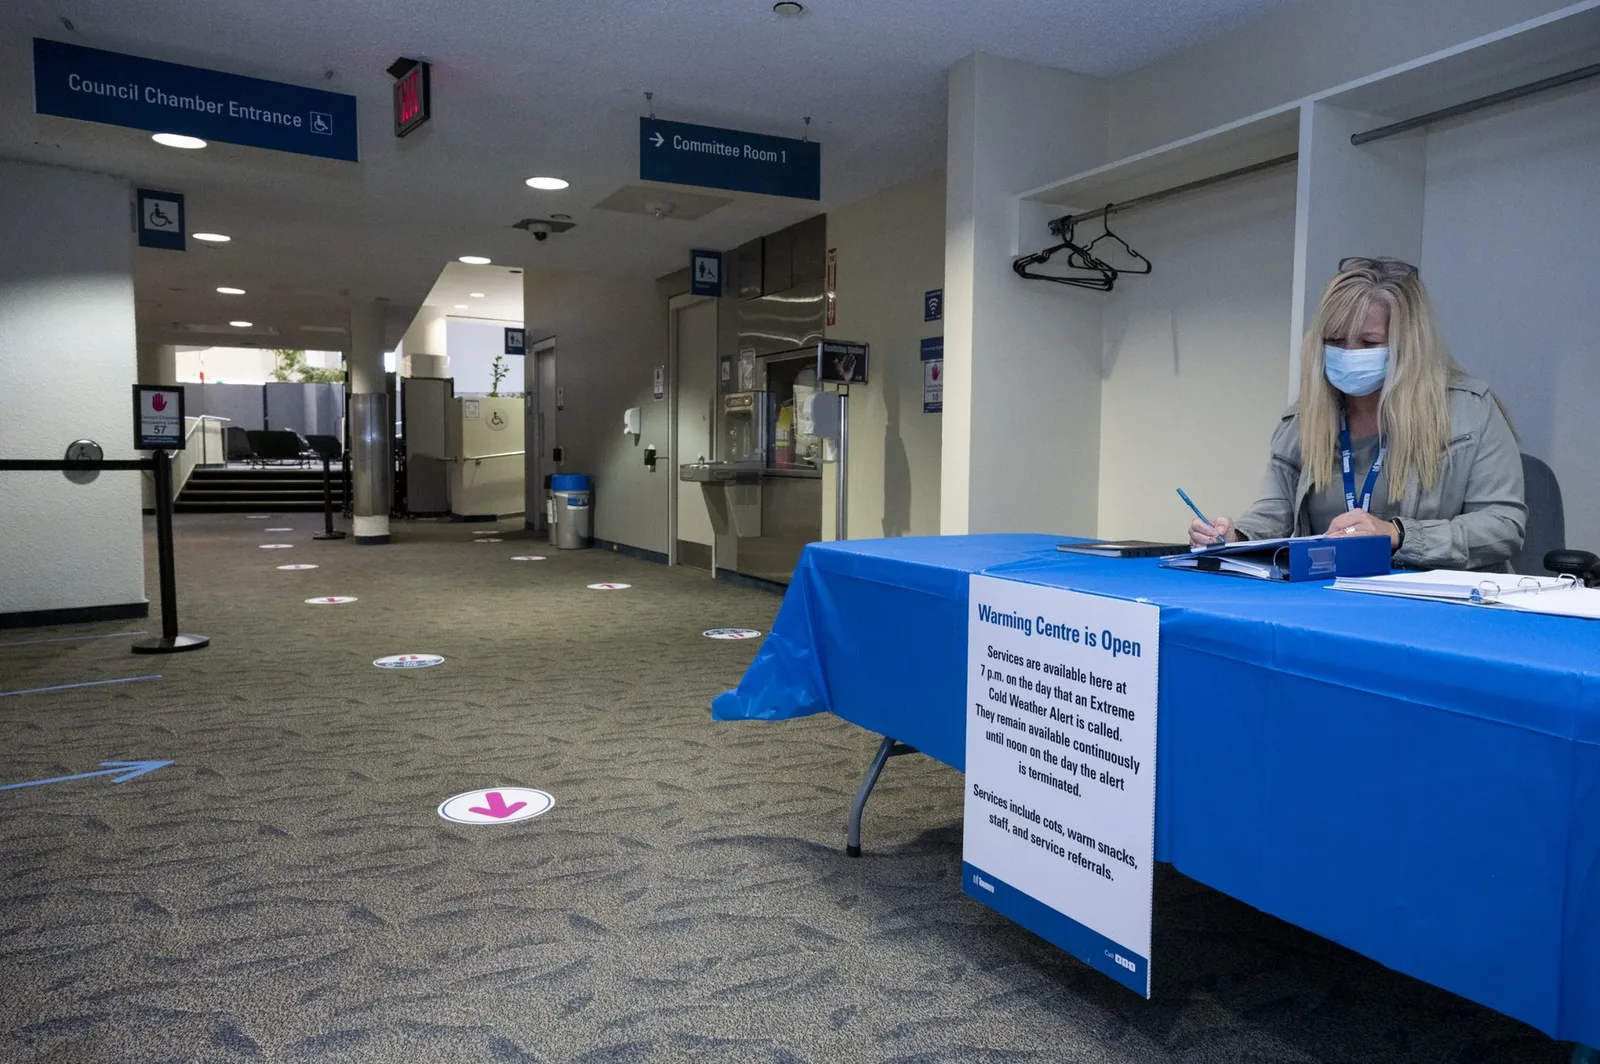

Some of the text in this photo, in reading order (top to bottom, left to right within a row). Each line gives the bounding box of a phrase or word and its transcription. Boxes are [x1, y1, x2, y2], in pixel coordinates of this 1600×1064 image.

[69, 73, 302, 128] Council Chamber Entrance
[673, 135, 786, 163] Committee Room 1
[153, 425, 167, 434] 57
[978, 603, 1141, 657] Warming Centre is Open
[980, 664, 1135, 721] 7 p.m. on the day that an Extreme
[987, 645, 1127, 694] Services are available here at
[975, 703, 1140, 775] They remain available continuously
[988, 687, 1123, 742] Cold Weather Alert is called.
[985, 730, 1125, 791] until noon on the day the alert
[1018, 760, 1082, 798] is terminated.
[973, 783, 1138, 870] Services include cots, warm snacks,
[988, 813, 1114, 881] staff, and service referrals.
